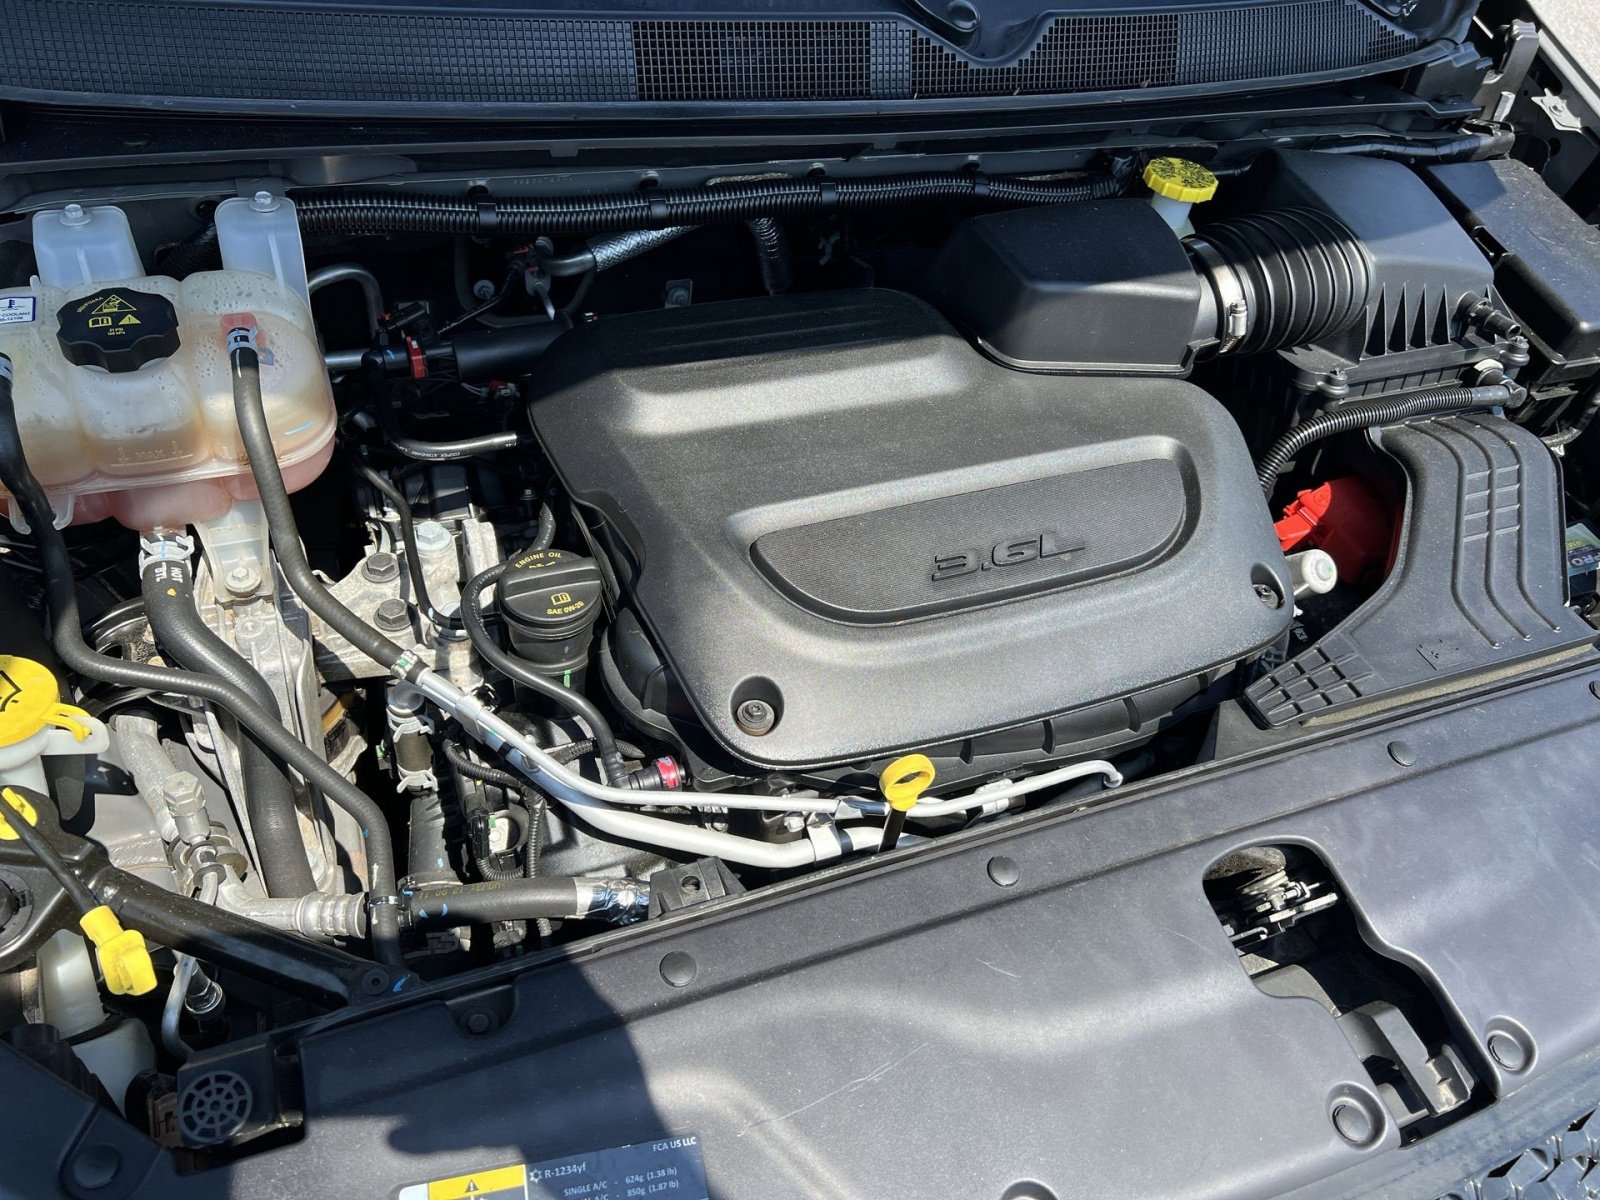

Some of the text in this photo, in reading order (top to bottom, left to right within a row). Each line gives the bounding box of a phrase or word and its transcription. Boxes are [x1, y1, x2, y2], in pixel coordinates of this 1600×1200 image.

[514, 551, 562, 569] ENGINE OIL
[931, 530, 1086, 583] 3.6L
[170, 566, 184, 584] HOT
[563, 601, 585, 613] 0W-20
[652, 1136, 697, 1152] FCA US LLC
[544, 1162, 586, 1178] R-1234yf
[563, 1184, 591, 1197] SINGLE
[592, 1180, 608, 1191] A/C
[625, 1174, 644, 1184] 624g
[646, 1169, 666, 1181] (1.38
[666, 1166, 677, 1176] lb)
[627, 1187, 646, 1198] 850g
[648, 1182, 667, 1194] (1.87
[668, 1179, 679, 1189] lb)
